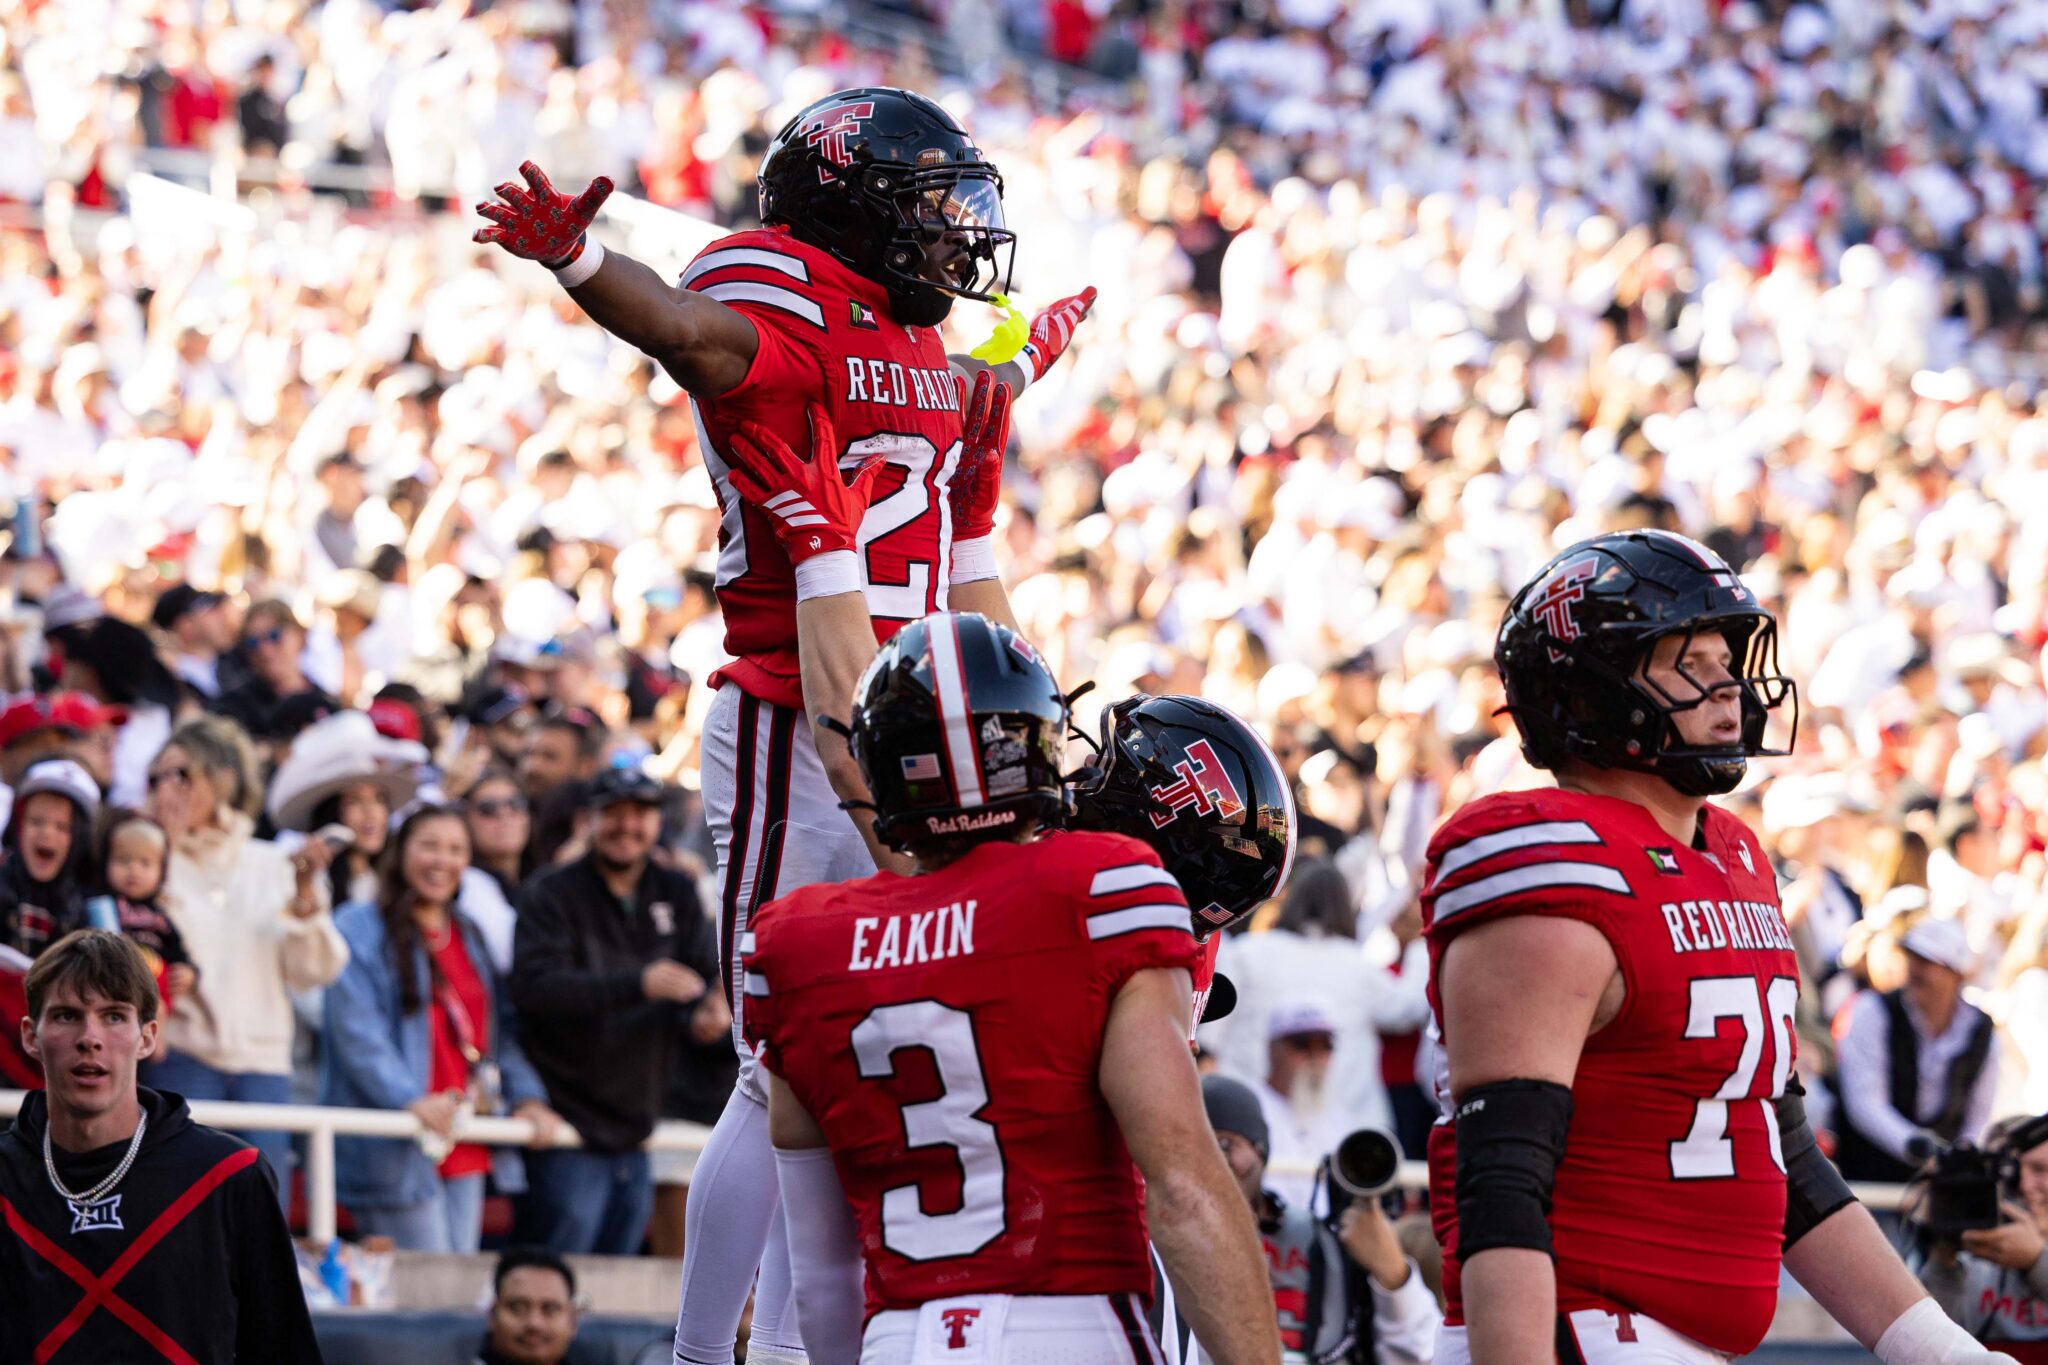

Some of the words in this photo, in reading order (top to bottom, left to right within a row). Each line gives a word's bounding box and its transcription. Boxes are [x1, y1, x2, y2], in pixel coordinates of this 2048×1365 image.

[845, 355, 908, 406] RED
[907, 367, 960, 412] RAID
[926, 816, 959, 834] Red
[957, 810, 1016, 832] Raiders
[847, 899, 978, 972] EAKIN
[1660, 899, 1727, 954] RED
[850, 997, 1008, 1262] 3
